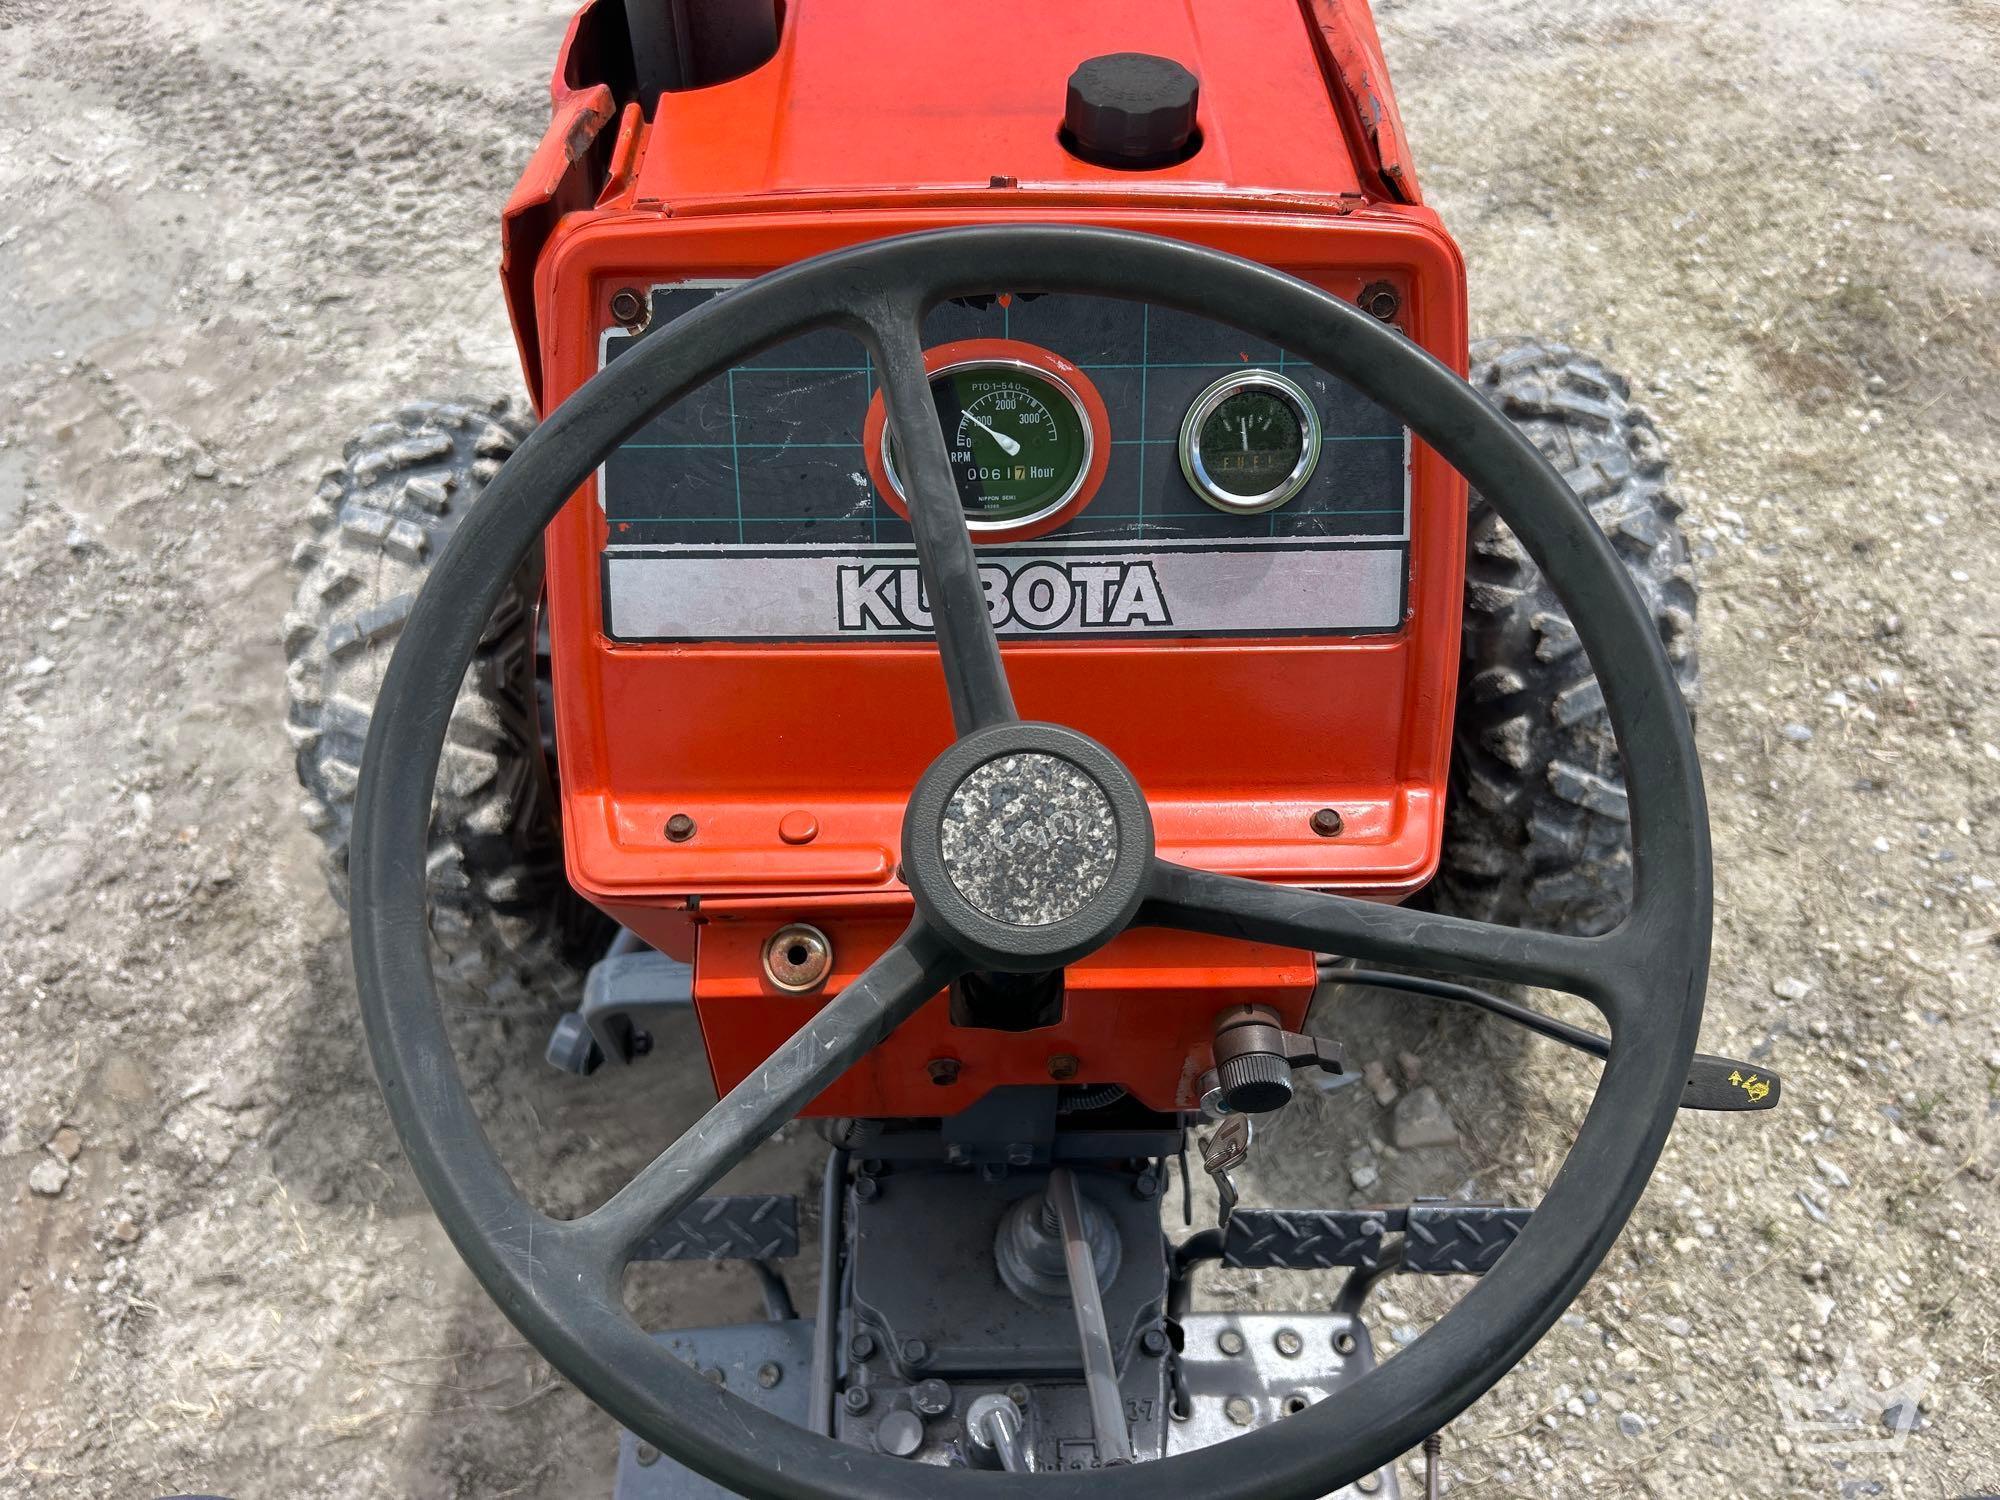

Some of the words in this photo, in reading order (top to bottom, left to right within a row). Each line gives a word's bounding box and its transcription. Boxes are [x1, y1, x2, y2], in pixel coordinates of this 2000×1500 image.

[995, 399, 1017, 411] 2000
[1019, 413, 1040, 424] 3000
[951, 451, 971, 463] RPM
[1030, 466, 1054, 478] Hour
